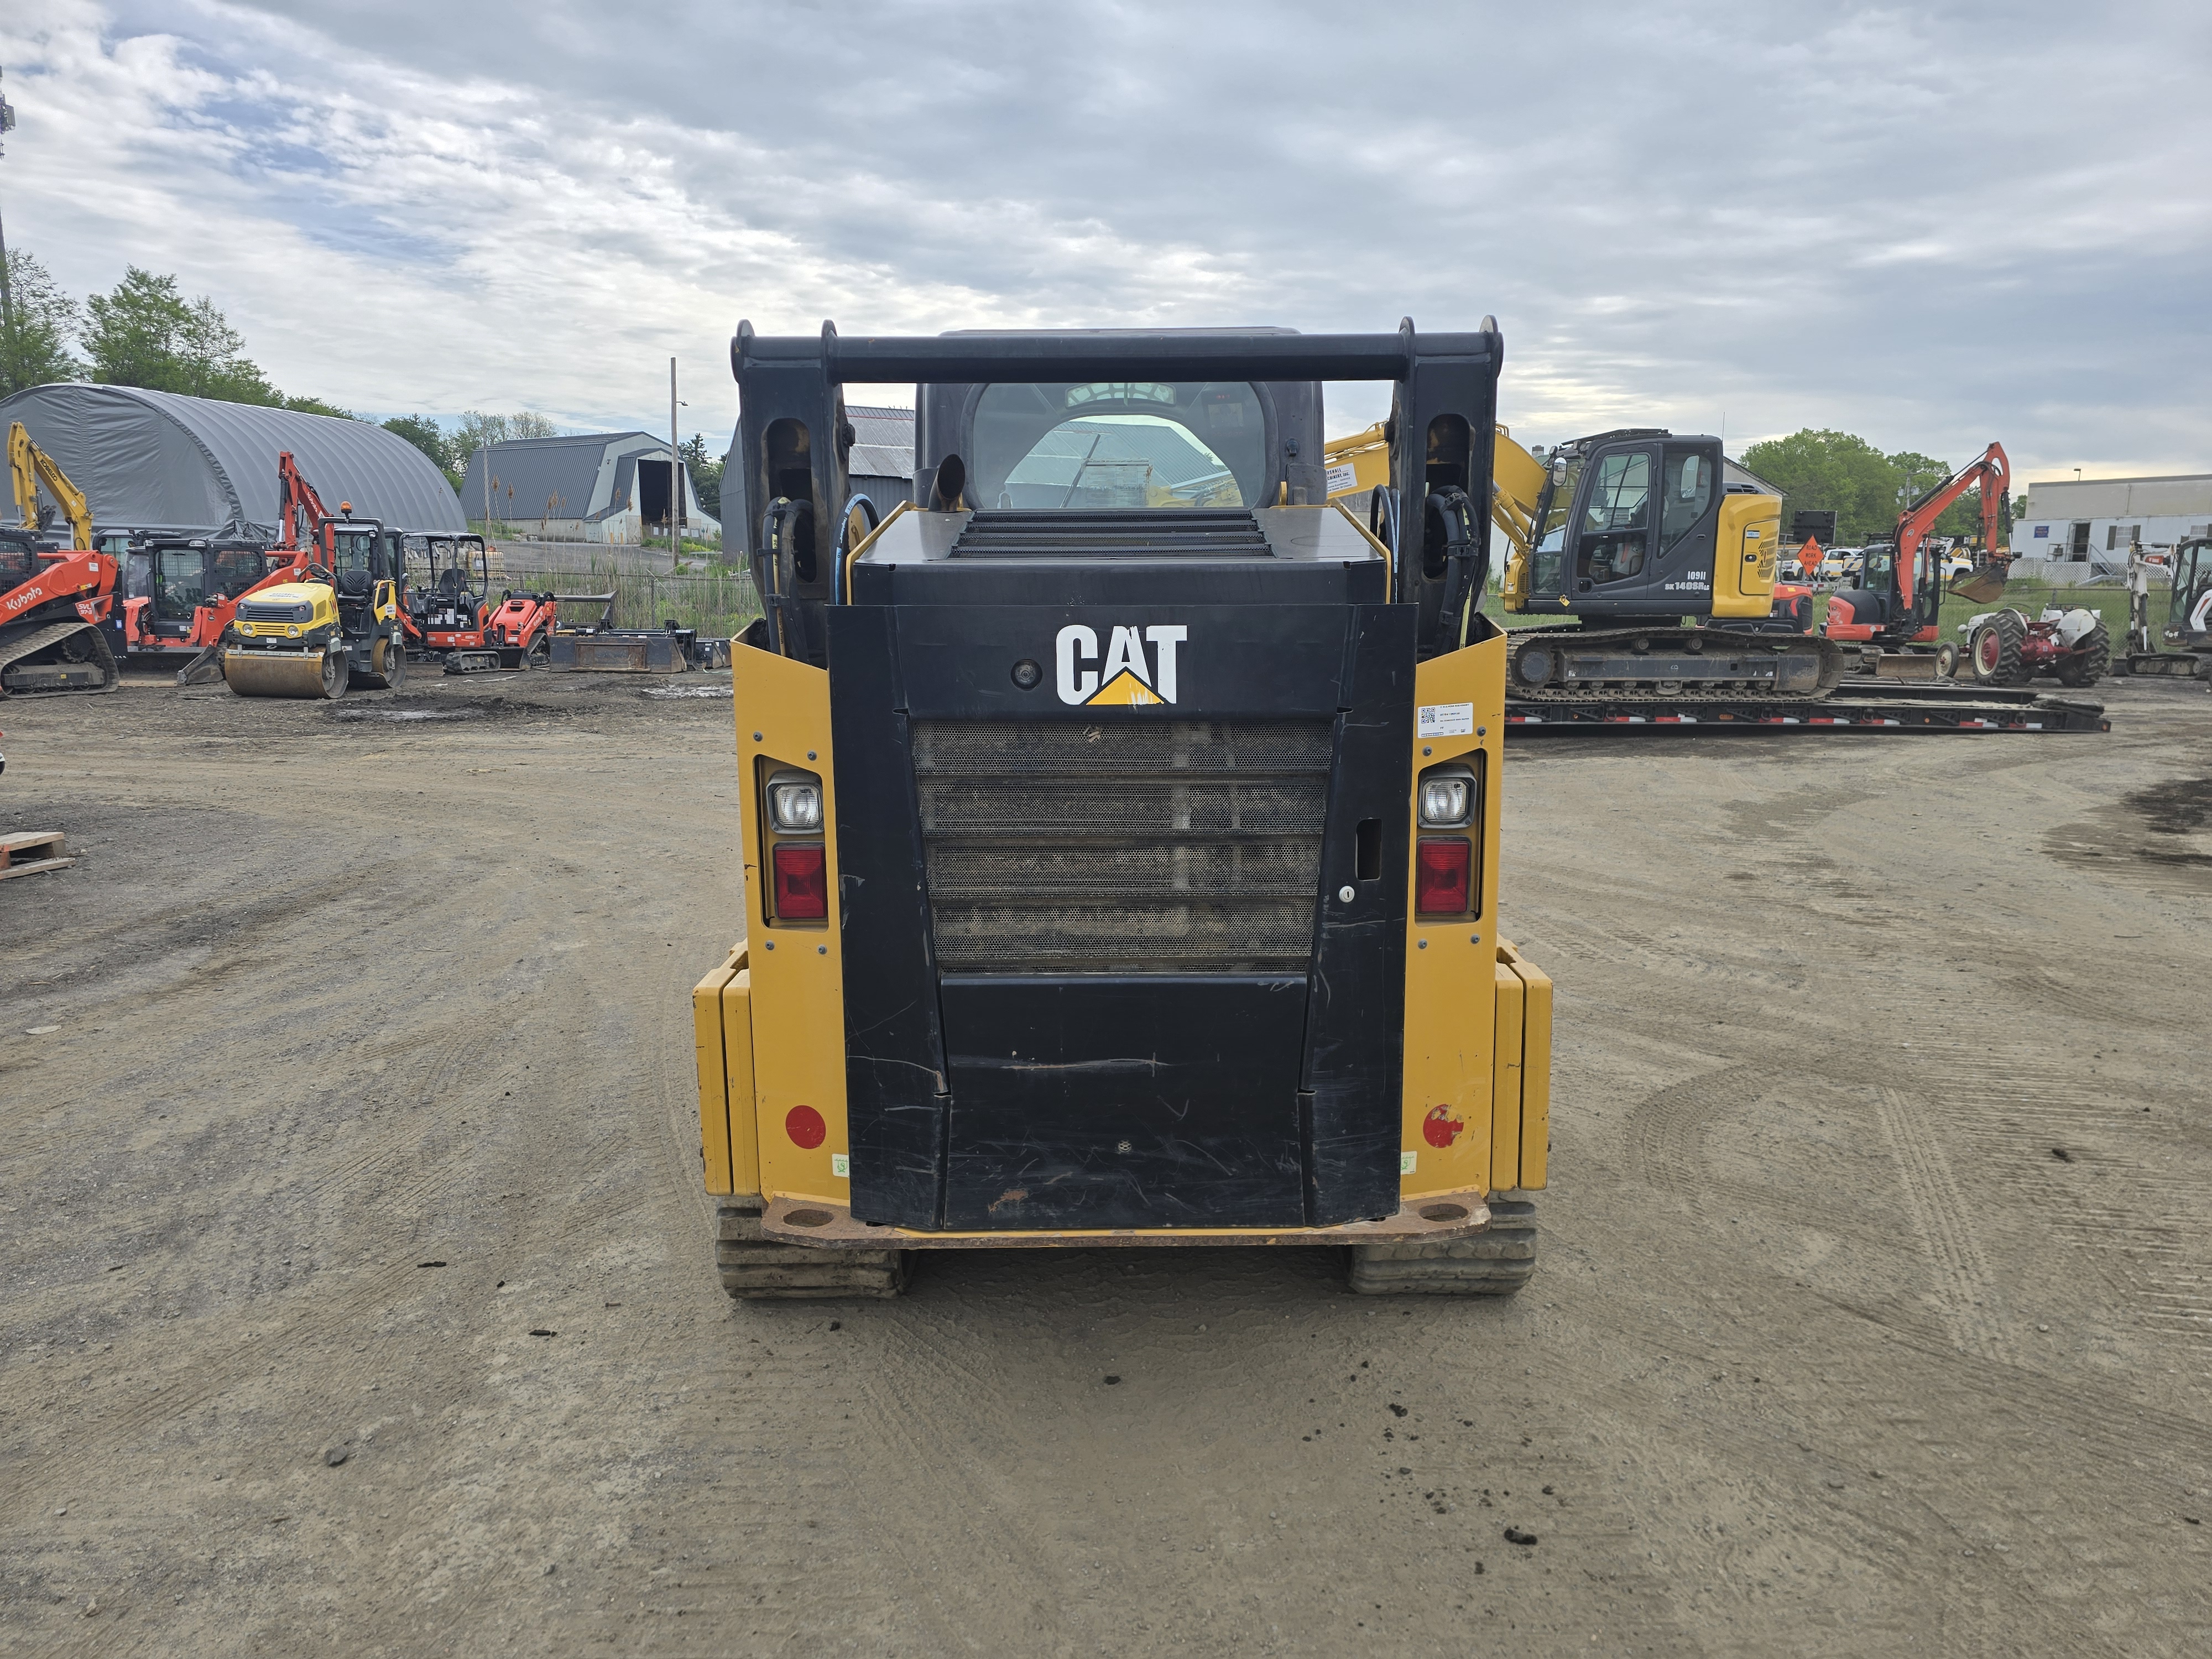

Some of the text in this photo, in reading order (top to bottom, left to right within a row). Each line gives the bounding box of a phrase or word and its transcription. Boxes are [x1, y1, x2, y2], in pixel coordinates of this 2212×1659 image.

[40, 458, 58, 482] KOBELCO
[1687, 571, 1707, 580] 10911
[6, 587, 43, 611] Kubota
[1056, 624, 1187, 705] CAT
